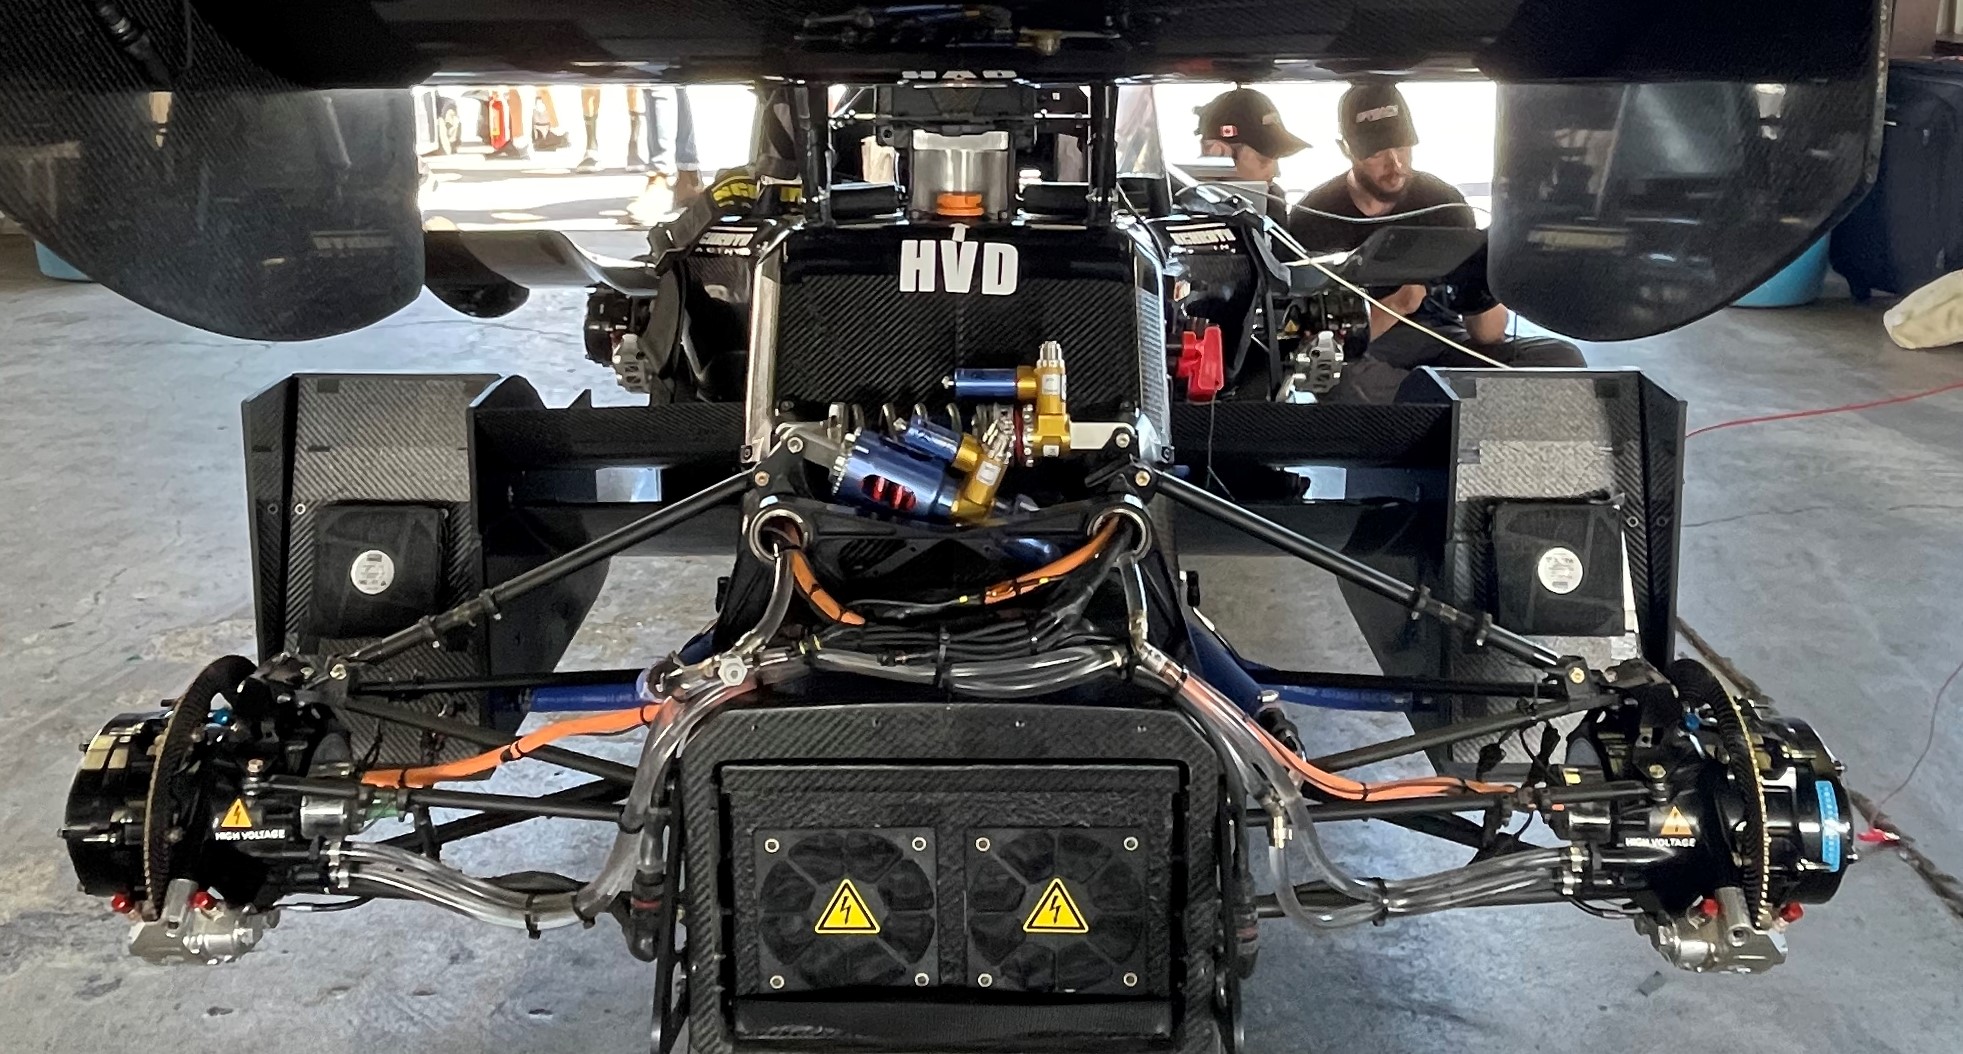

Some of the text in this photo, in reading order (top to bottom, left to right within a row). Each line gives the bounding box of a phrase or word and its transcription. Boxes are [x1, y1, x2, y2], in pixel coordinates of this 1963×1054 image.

[899, 239, 1019, 296] HVD
[214, 829, 286, 841] HIGH VOLTAGE
[1624, 837, 1697, 848] HIGH VOLTAGE
